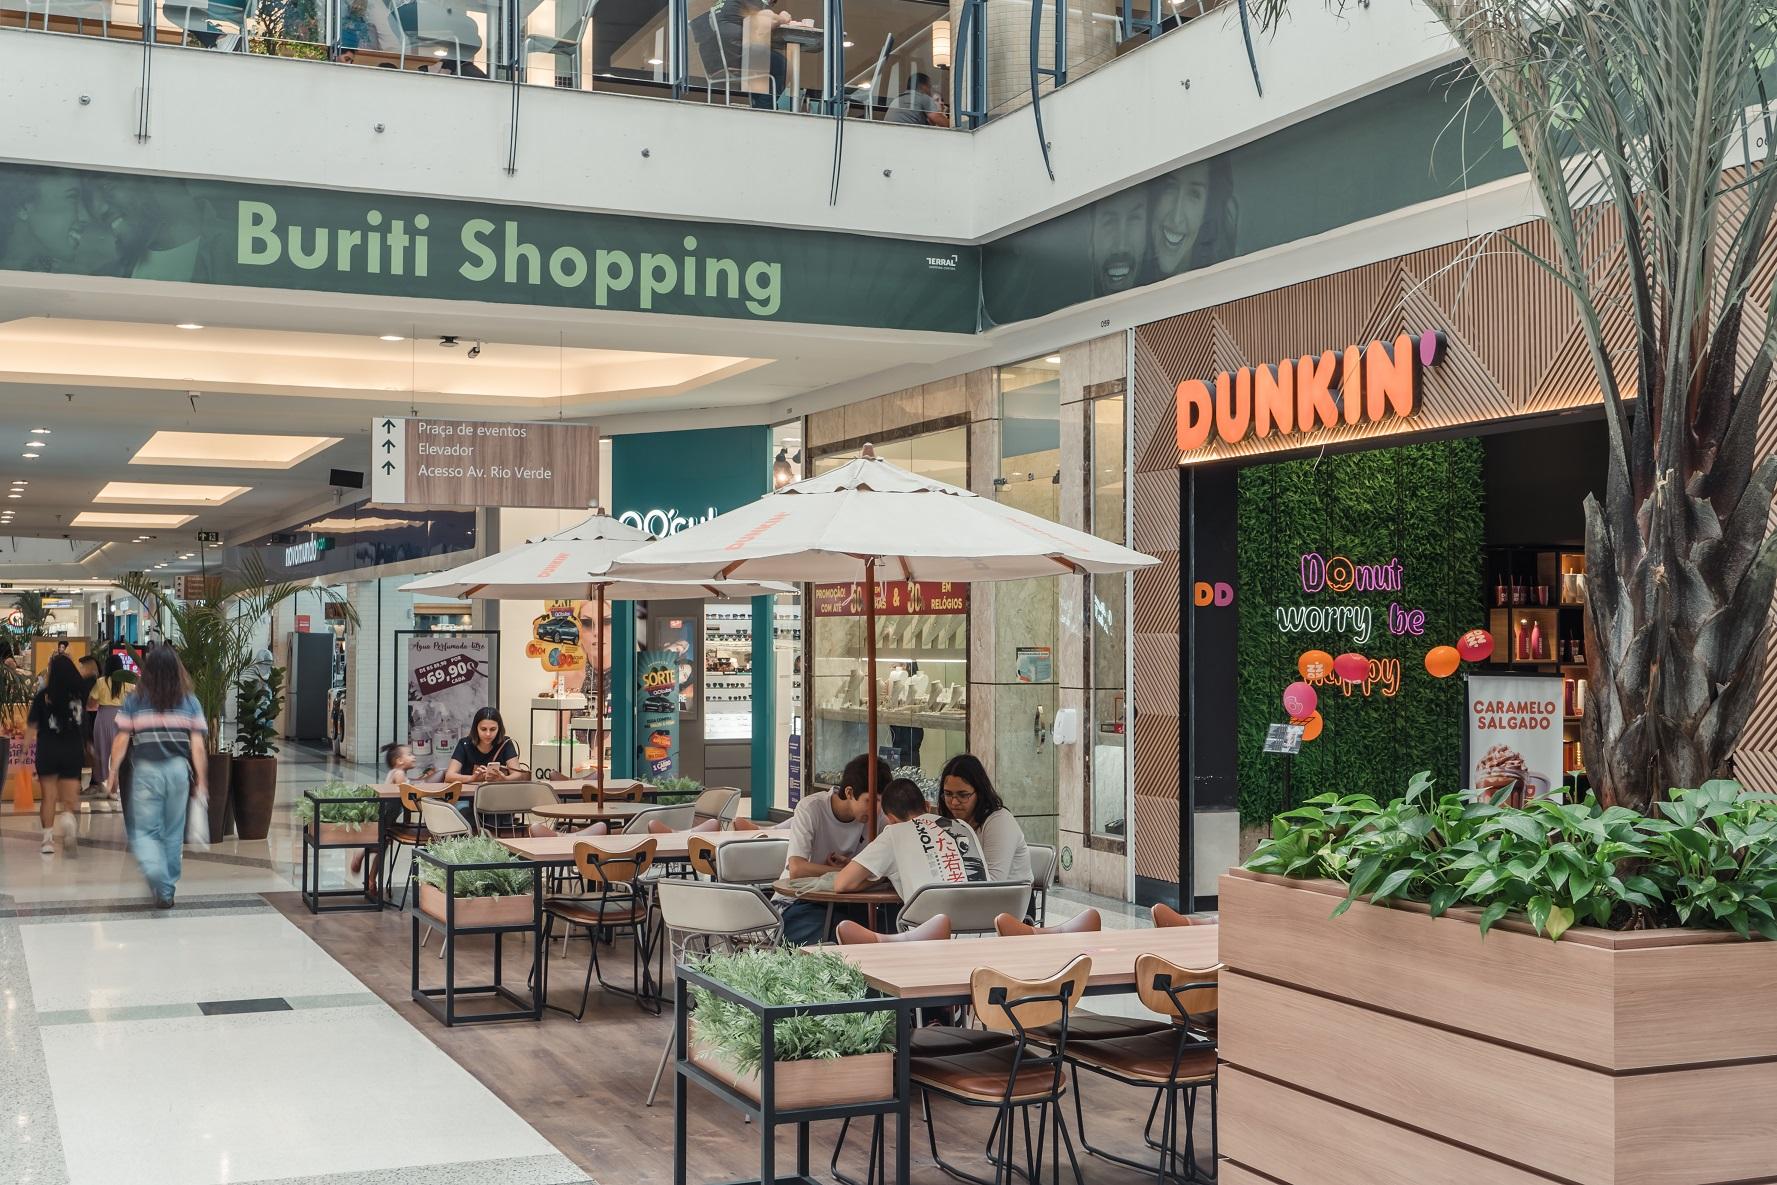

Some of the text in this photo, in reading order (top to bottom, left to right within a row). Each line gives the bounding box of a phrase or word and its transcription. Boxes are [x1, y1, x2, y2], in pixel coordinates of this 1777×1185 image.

[238, 200, 782, 316] Buriti Shopping
[926, 257, 956, 267] TERRAL
[1177, 329, 1438, 451] DUNKIN'
[418, 422, 527, 438] Praça de eventos
[418, 442, 474, 456] Elevador
[418, 465, 552, 480] Acesso Av. Rio Verde
[1301, 552, 1404, 593] Donut
[815, 585, 846, 601] PROMOÇÃO!
[941, 582, 952, 593] EM
[1194, 581, 1234, 607] DD
[893, 587, 900, 607] &
[931, 595, 963, 610] RELÓGIOS
[821, 601, 843, 613] COM ATÉ
[1276, 602, 1425, 644] worry be
[426, 661, 467, 686] 69,90
[451, 675, 466, 684] CADA
[643, 670, 675, 687] SORTE
[1473, 700, 1556, 715] CARAMELO
[1477, 716, 1551, 730] SALGADO
